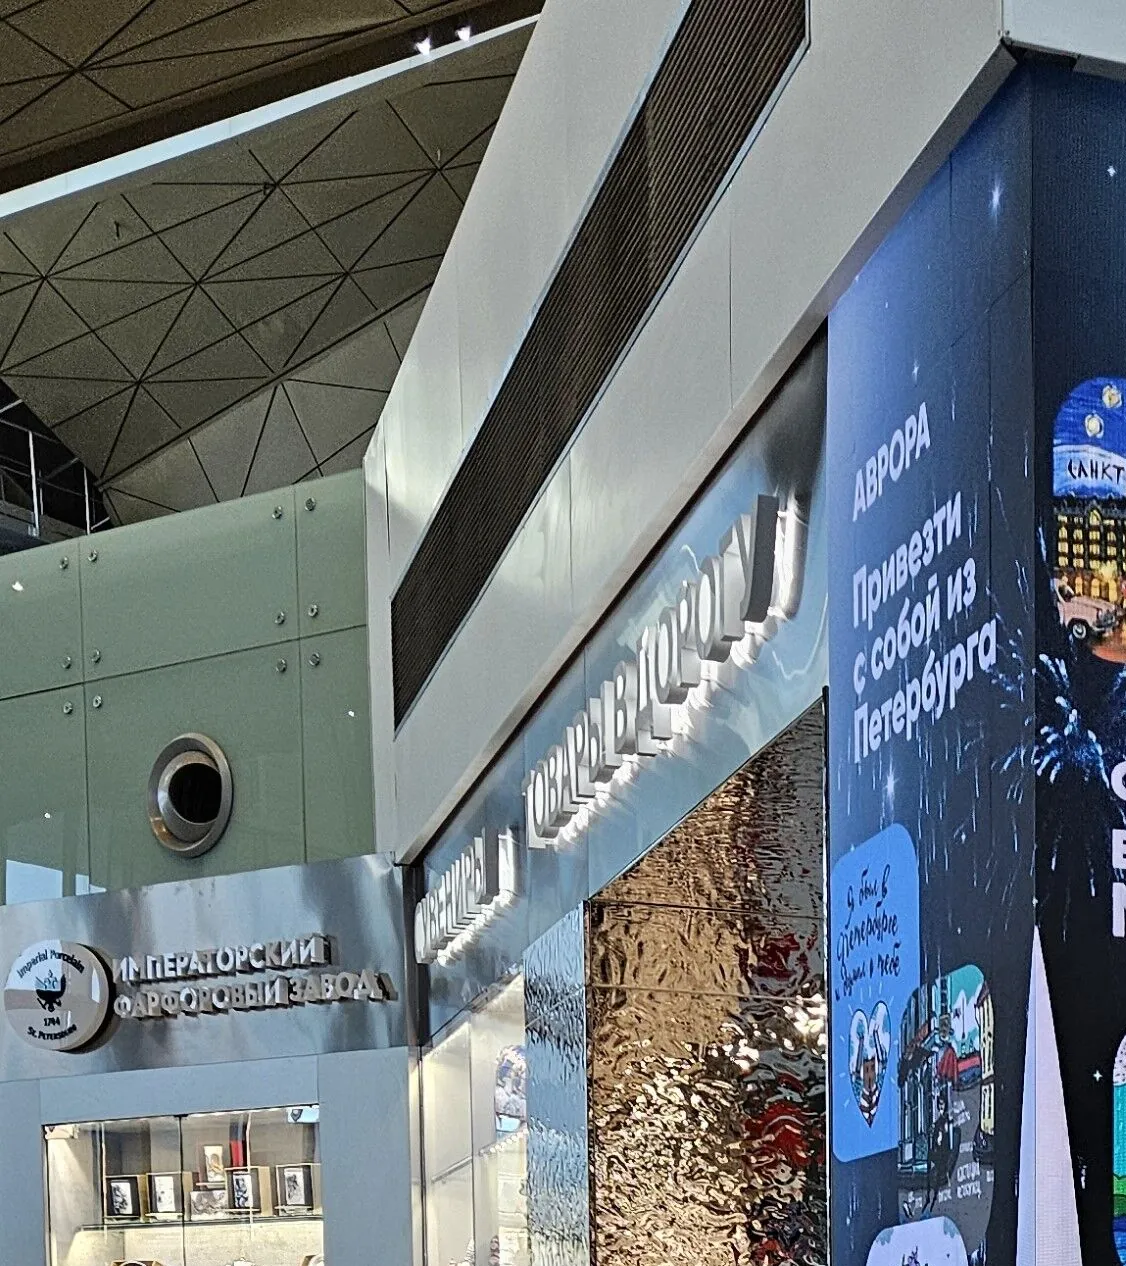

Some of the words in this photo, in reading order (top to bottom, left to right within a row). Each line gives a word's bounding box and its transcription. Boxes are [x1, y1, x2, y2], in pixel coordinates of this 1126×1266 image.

[852, 401, 931, 522] АВРОРА
[1067, 459, 1125, 485] САНКТ
[852, 491, 962, 631] Привезти
[853, 651, 867, 695] с
[870, 573, 940, 681] собой
[947, 557, 977, 621] из
[853, 618, 997, 764] Петербурга
[113, 935, 330, 983] ИМПЕРАТОРСКИЙ
[114, 977, 290, 1020] ФАРФОРОВЫЙ
[290, 968, 384, 1003] ЗАВОД
